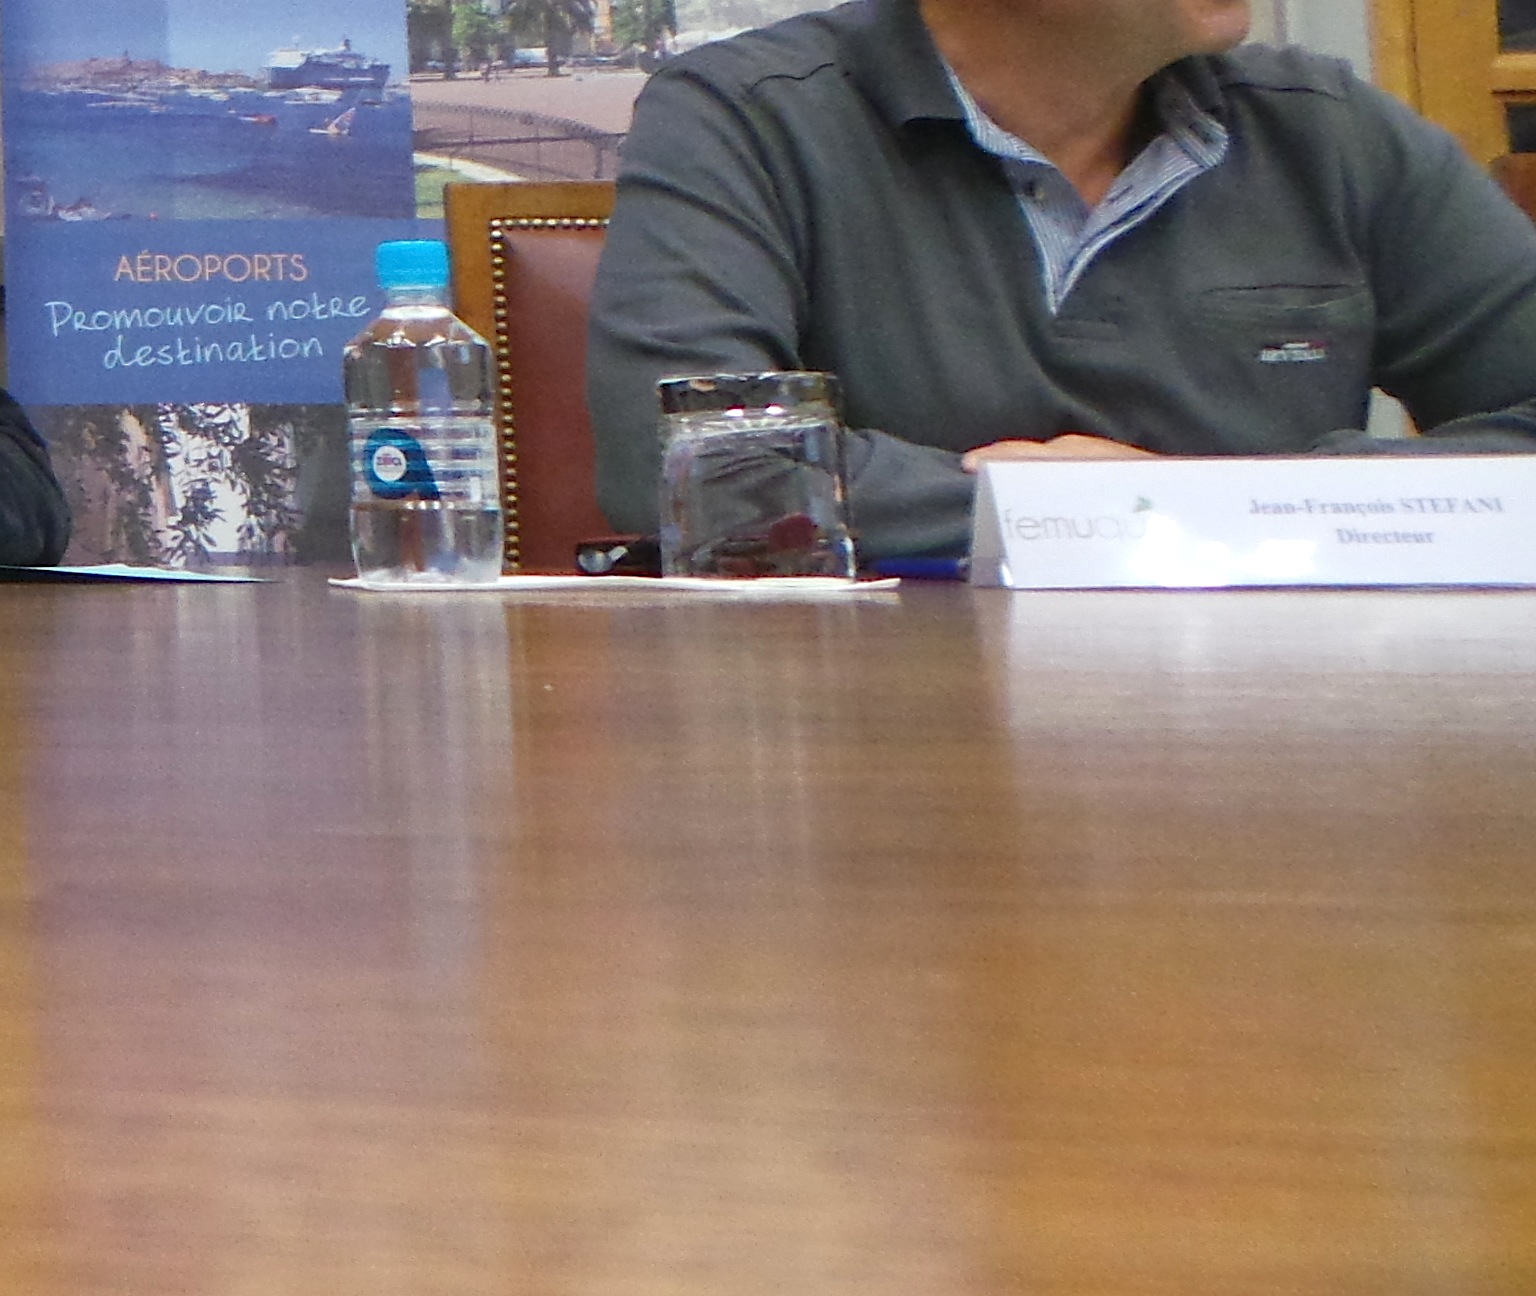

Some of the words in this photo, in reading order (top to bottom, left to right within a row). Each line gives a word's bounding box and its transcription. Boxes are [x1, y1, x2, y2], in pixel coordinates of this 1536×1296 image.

[114, 250, 308, 283] AÉROPORTS
[44, 297, 253, 337] Promouvoir
[267, 294, 370, 321] notre
[104, 334, 324, 369] destination
[1249, 497, 1394, 520] Jean-François
[1398, 497, 1505, 514] STEFANI
[1336, 528, 1436, 545] Directeur
